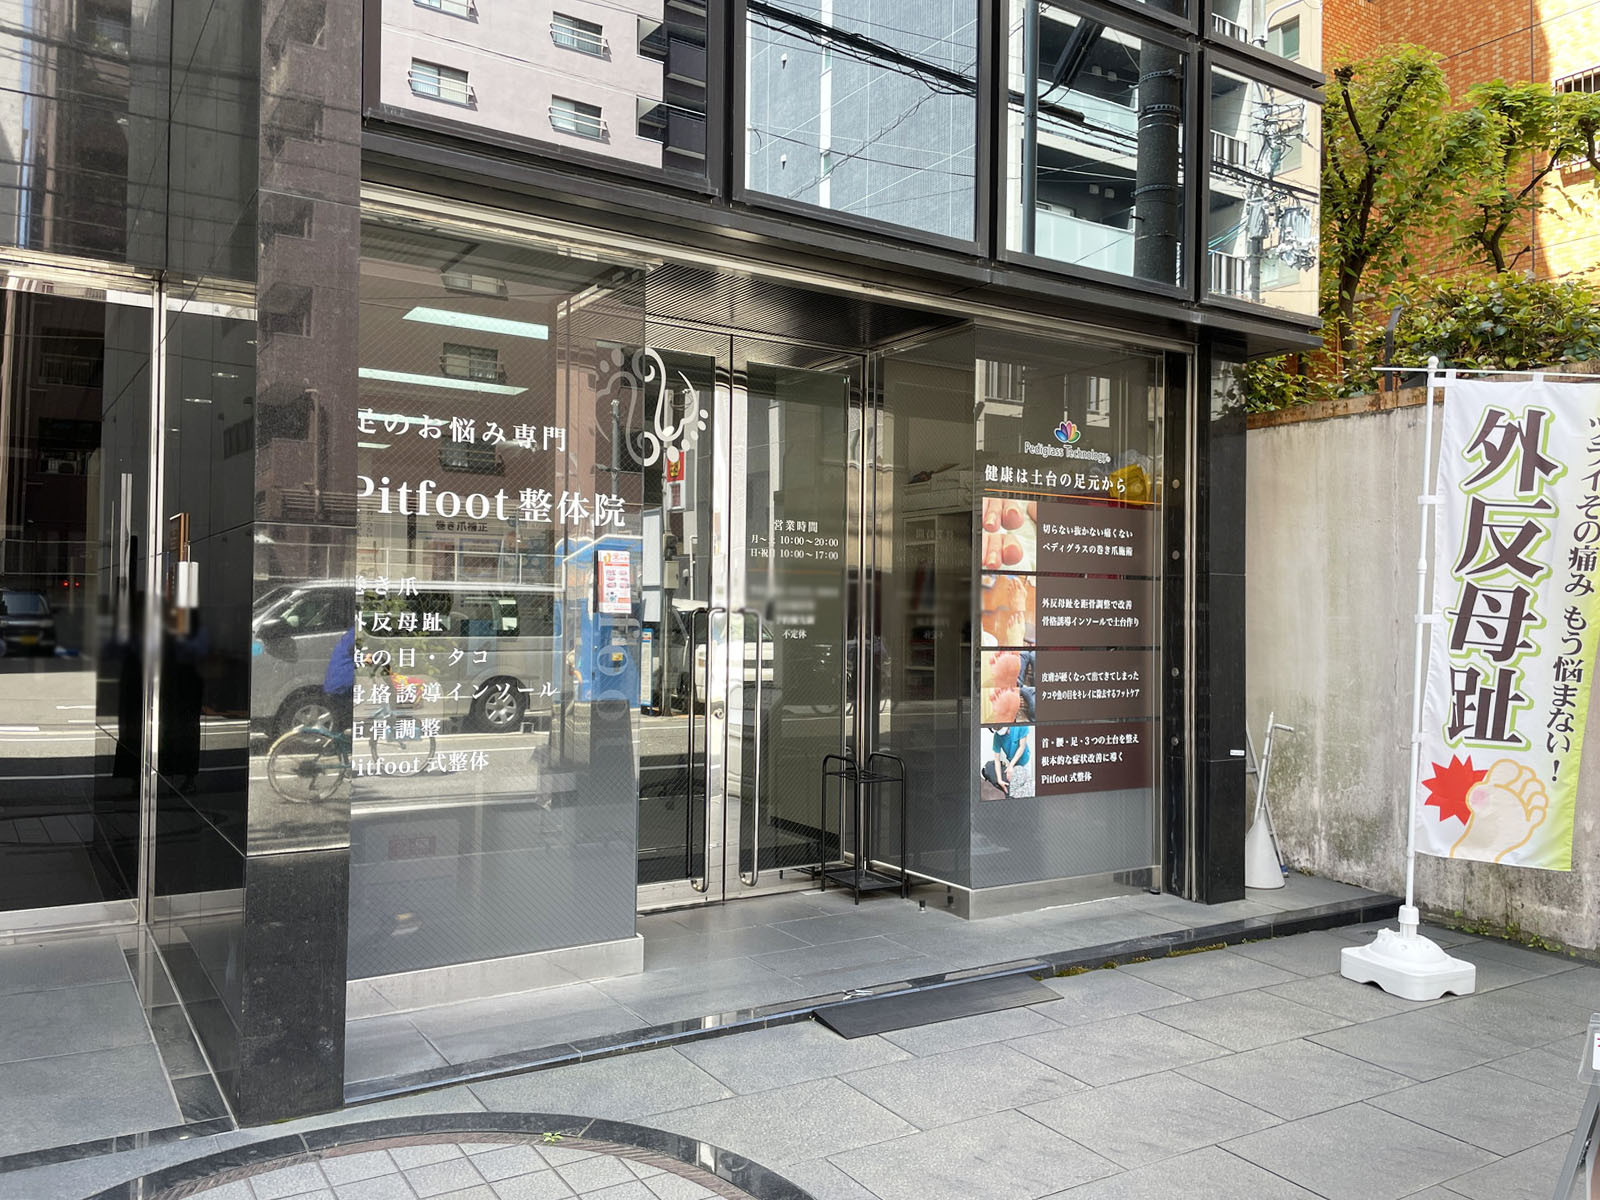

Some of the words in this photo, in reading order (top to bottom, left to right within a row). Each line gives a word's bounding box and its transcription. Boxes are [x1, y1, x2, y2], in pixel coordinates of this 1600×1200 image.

[1024, 441, 1064, 458] Pediglass
[985, 464, 1126, 493] 健康は土台の足元から
[518, 487, 626, 527] 整体院
[774, 520, 818, 533] 営業時間
[1042, 524, 1133, 538] 切らない抜かない痛くない
[1447, 406, 1561, 746] 外反母趾
[782, 629, 807, 639] 不定休
[352, 757, 420, 777] itfoot
[427, 752, 489, 773] 式整体
[1041, 752, 1123, 767] 根本的な症状改善に導く
[1041, 774, 1068, 784] Pitfoot
[1069, 771, 1092, 782] 式整体
